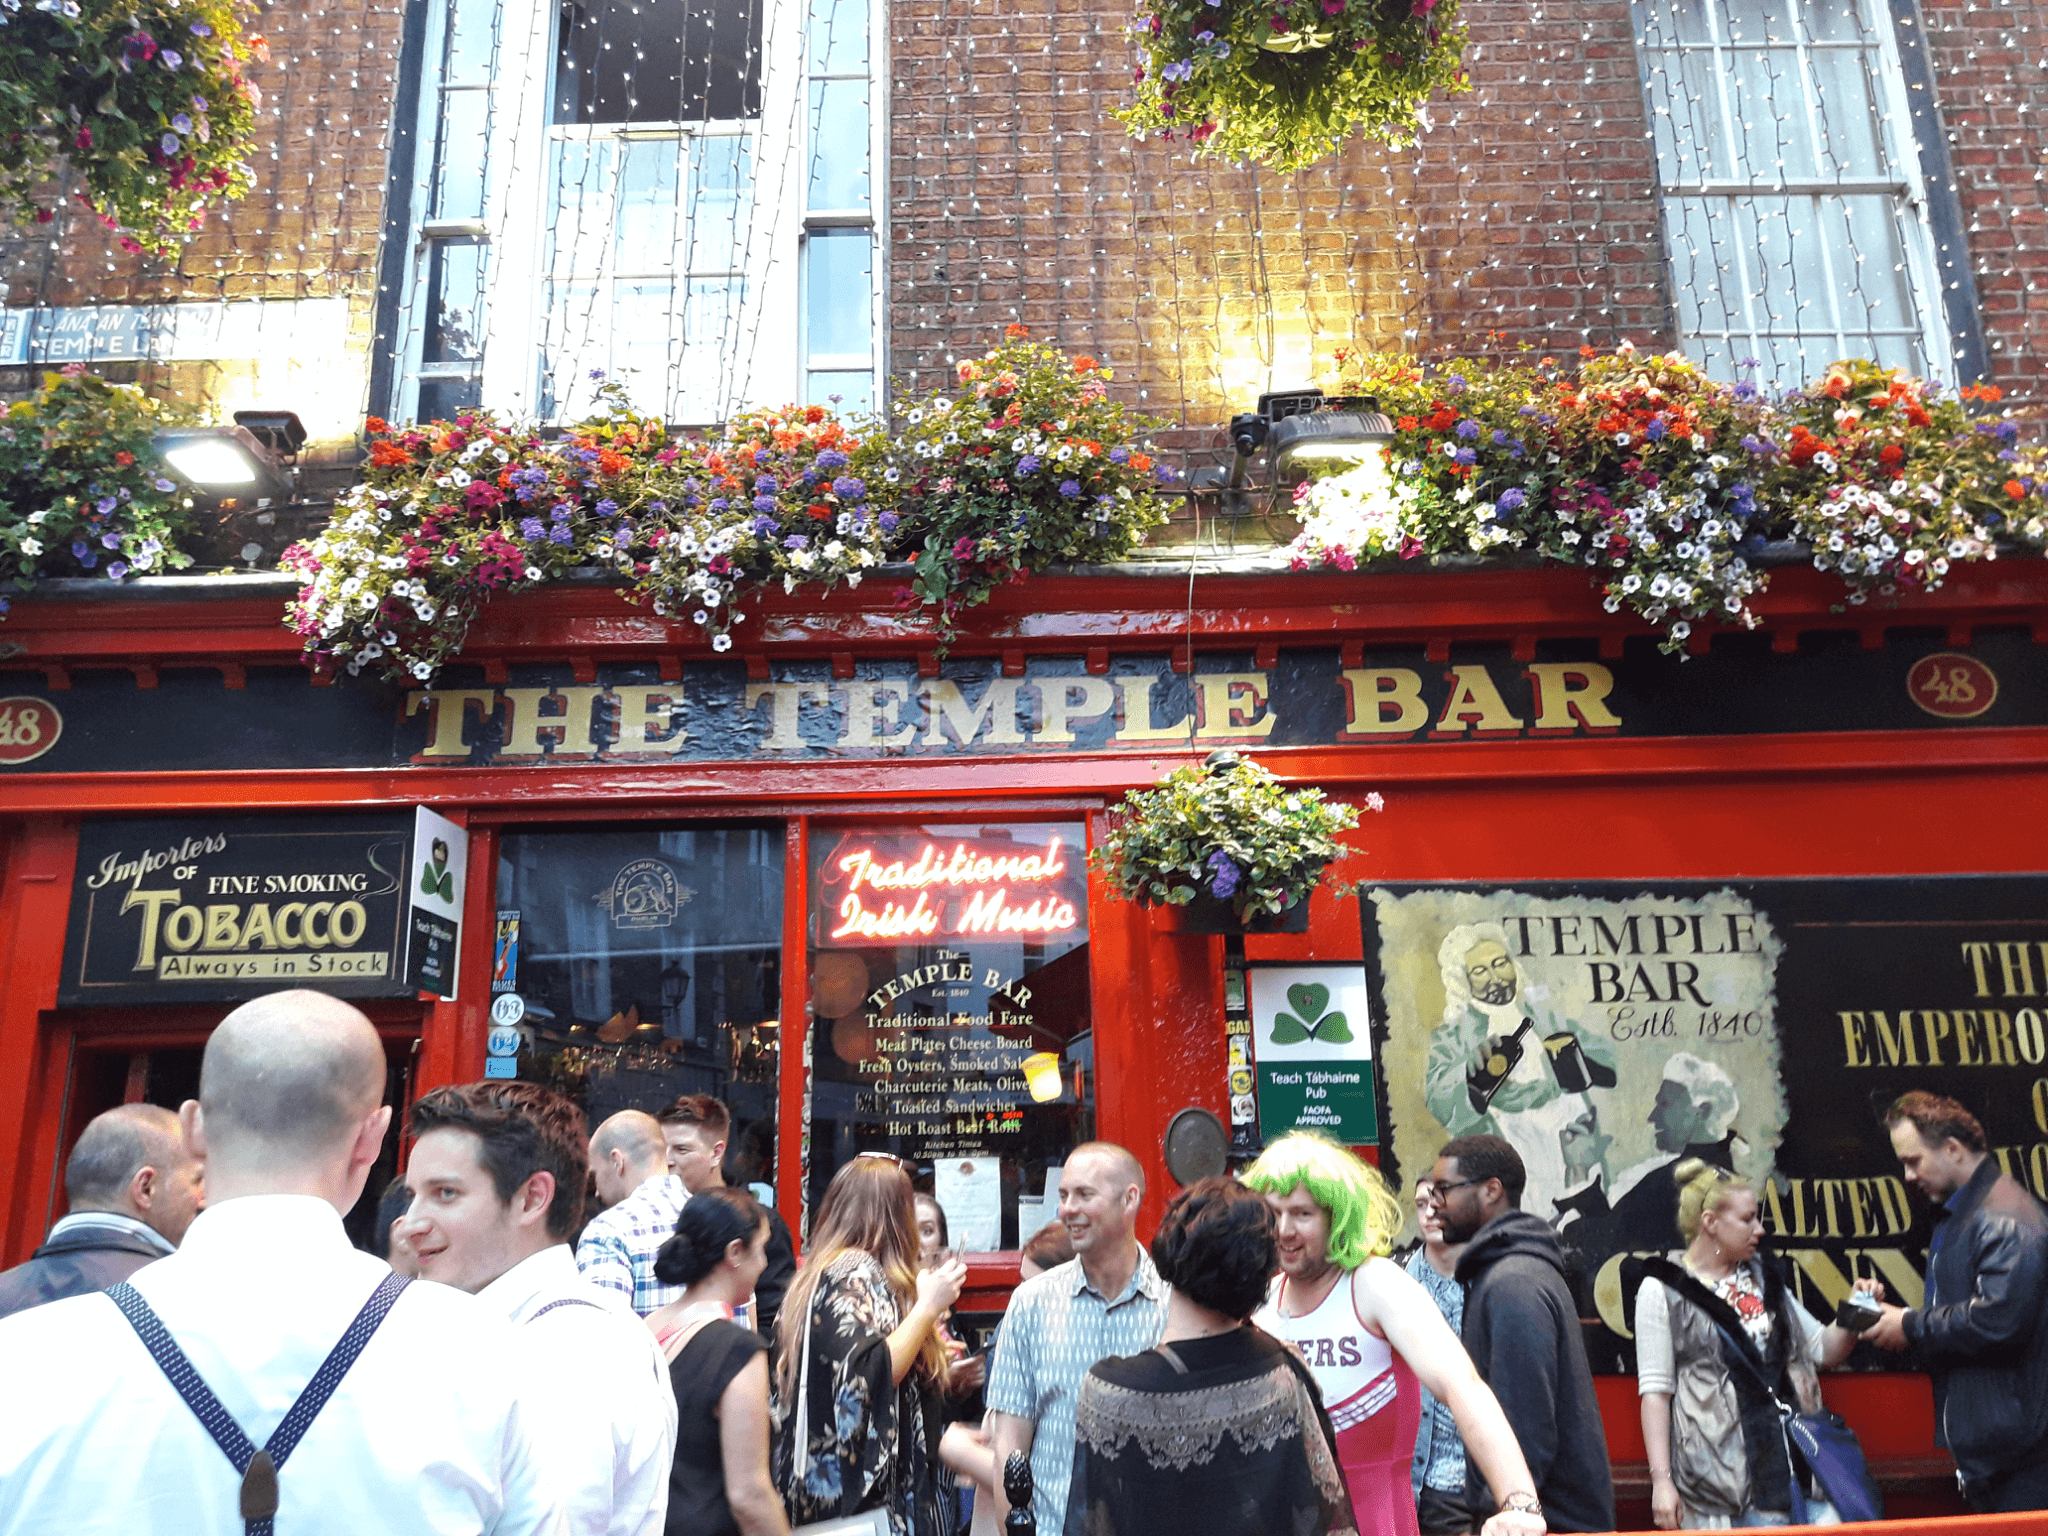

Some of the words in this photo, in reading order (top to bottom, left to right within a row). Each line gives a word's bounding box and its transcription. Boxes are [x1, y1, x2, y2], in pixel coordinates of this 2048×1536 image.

[1921, 664, 1976, 703] 48
[405, 685, 688, 758] THE
[744, 672, 1277, 750] TEMPLE
[1343, 662, 1623, 735] BAR
[0, 706, 40, 745] 48
[87, 832, 226, 889] Importers
[173, 865, 198, 880] OF
[838, 835, 1065, 891] Traditional
[207, 875, 259, 895] FINE
[263, 873, 369, 894] SMOKING
[831, 891, 938, 938] Irish
[957, 887, 1076, 933] Music
[119, 888, 367, 971] TOBACCO
[1502, 912, 1763, 958] TEMPLE
[164, 956, 258, 976] Always
[273, 956, 297, 974] in
[308, 953, 383, 973] Stock
[936, 949, 960, 960] The
[867, 963, 974, 1010] TEMPLE
[982, 968, 1034, 1009] BAR
[1584, 960, 1714, 1008] BAR
[865, 1011, 950, 1028] Traditional
[955, 1011, 994, 1026] Food
[1000, 1010, 1034, 1025] Fare
[1698, 1010, 1764, 1037] 1840
[996, 1034, 1033, 1050] Board
[1837, 1006, 2048, 1068] EMPERO
[858, 1059, 893, 1074] Fresh
[949, 1055, 998, 1071] Smoked
[1003, 1055, 1023, 1070] Sal
[1270, 1071, 1303, 1085] Teach
[873, 1077, 948, 1093] Charcuterie
[997, 1075, 1031, 1092] Olive
[1305, 1085, 1328, 1099] Pub
[893, 1098, 941, 1115] Toasted
[945, 1097, 1016, 1114] Sandwiches
[889, 1120, 913, 1136] Hot
[917, 1119, 952, 1136] Roast
[956, 1118, 986, 1135] Beef
[1295, 1115, 1342, 1126] APPROVED
[1759, 1175, 1912, 1239] ALTED
[1297, 1335, 1363, 1368] ERS
